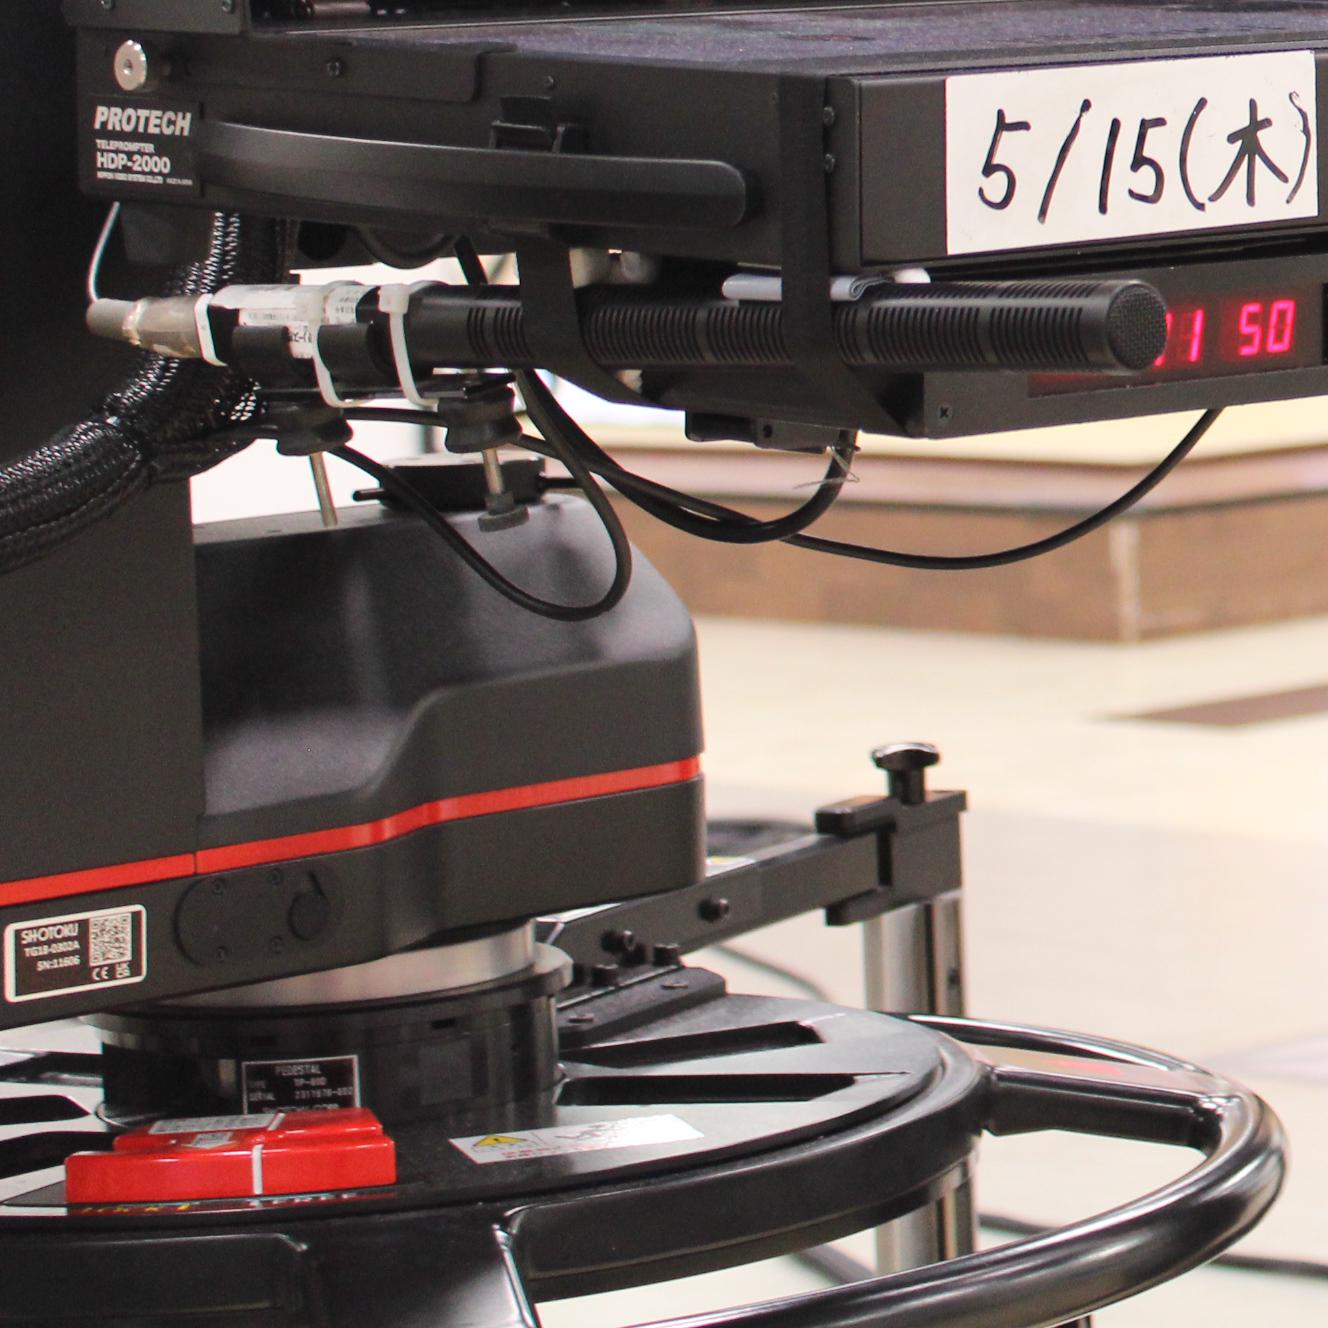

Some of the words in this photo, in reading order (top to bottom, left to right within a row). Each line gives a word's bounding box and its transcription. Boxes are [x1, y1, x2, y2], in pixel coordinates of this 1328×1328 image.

[94, 105, 192, 137] PROTECH
[96, 139, 156, 153] TELEPROMPTER
[978, 90, 1311, 223] 5/15(木)
[97, 152, 171, 174] HDP-2000
[1238, 298, 1296, 356] 50
[21, 923, 79, 944] SHOTOKU
